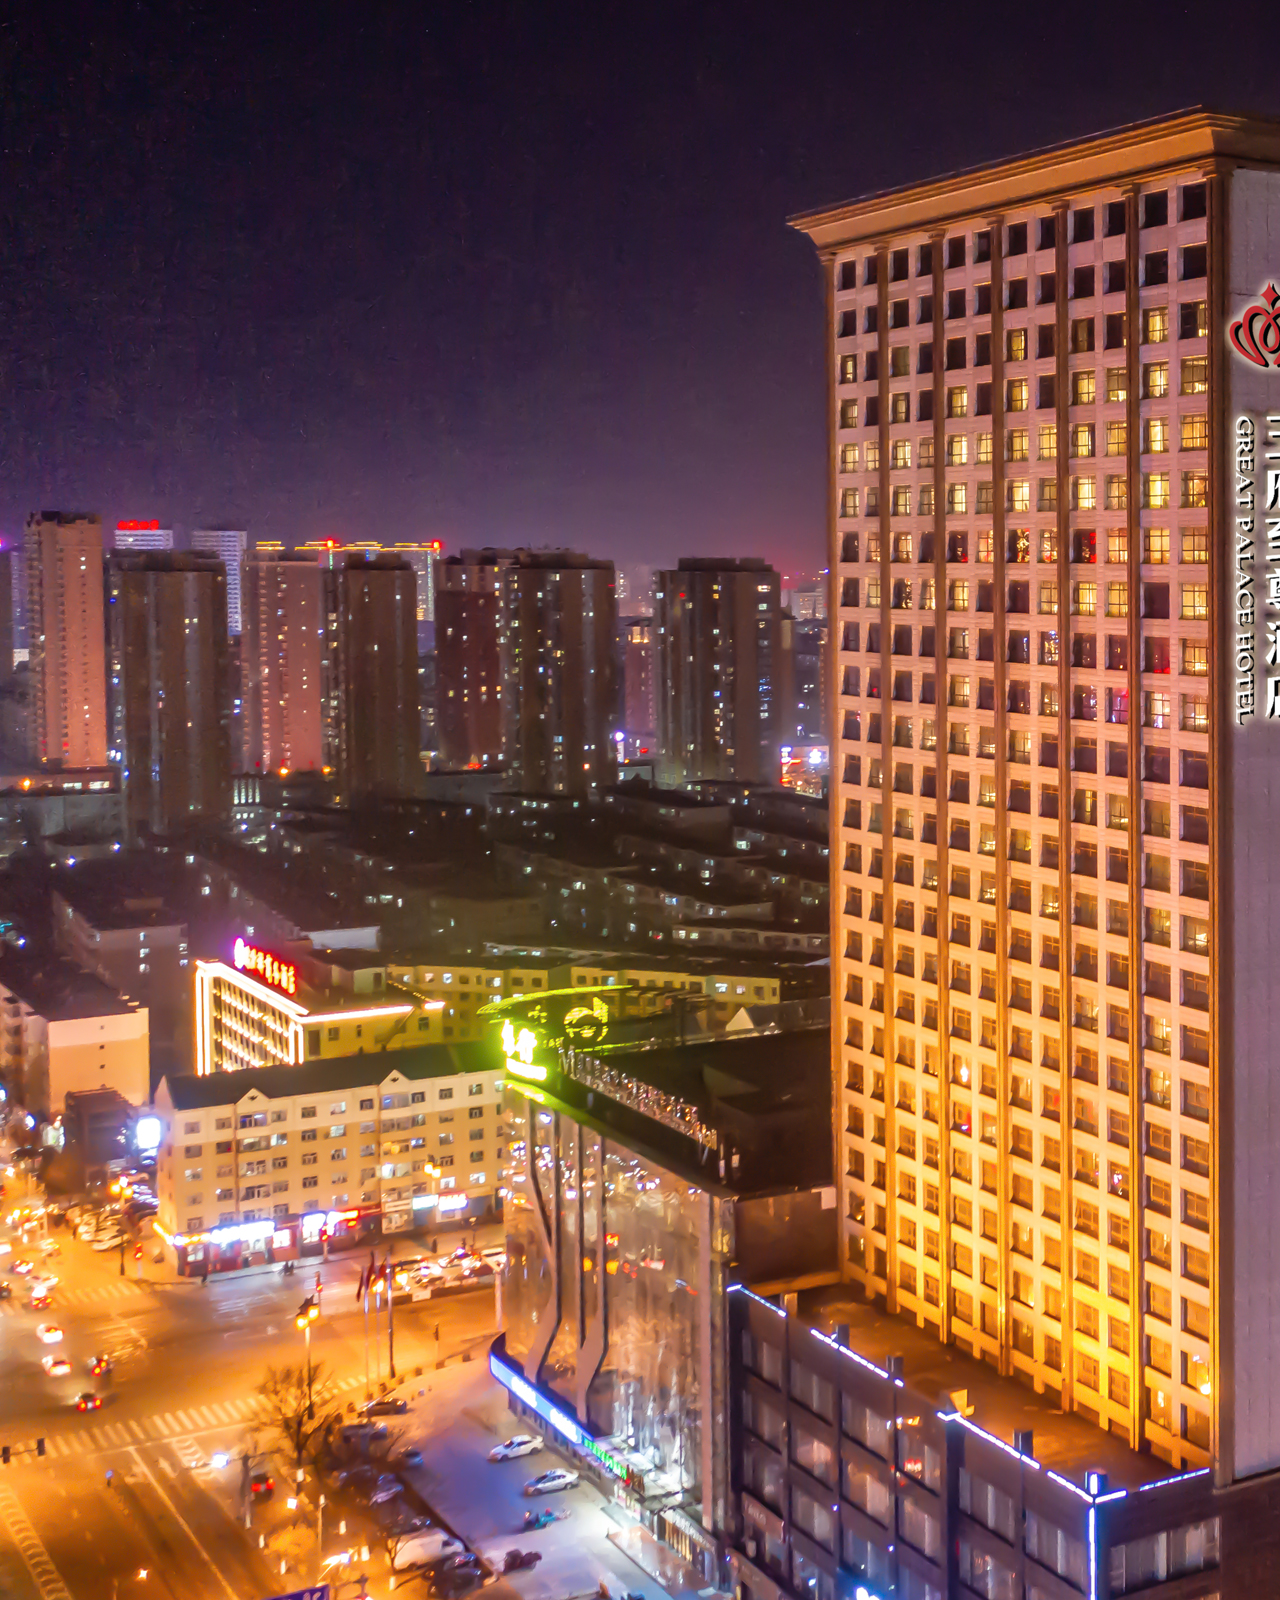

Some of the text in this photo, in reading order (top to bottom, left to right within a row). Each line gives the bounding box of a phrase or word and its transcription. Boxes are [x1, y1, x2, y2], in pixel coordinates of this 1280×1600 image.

[1235, 415, 1254, 725] GREAT PALACE HOTEL
